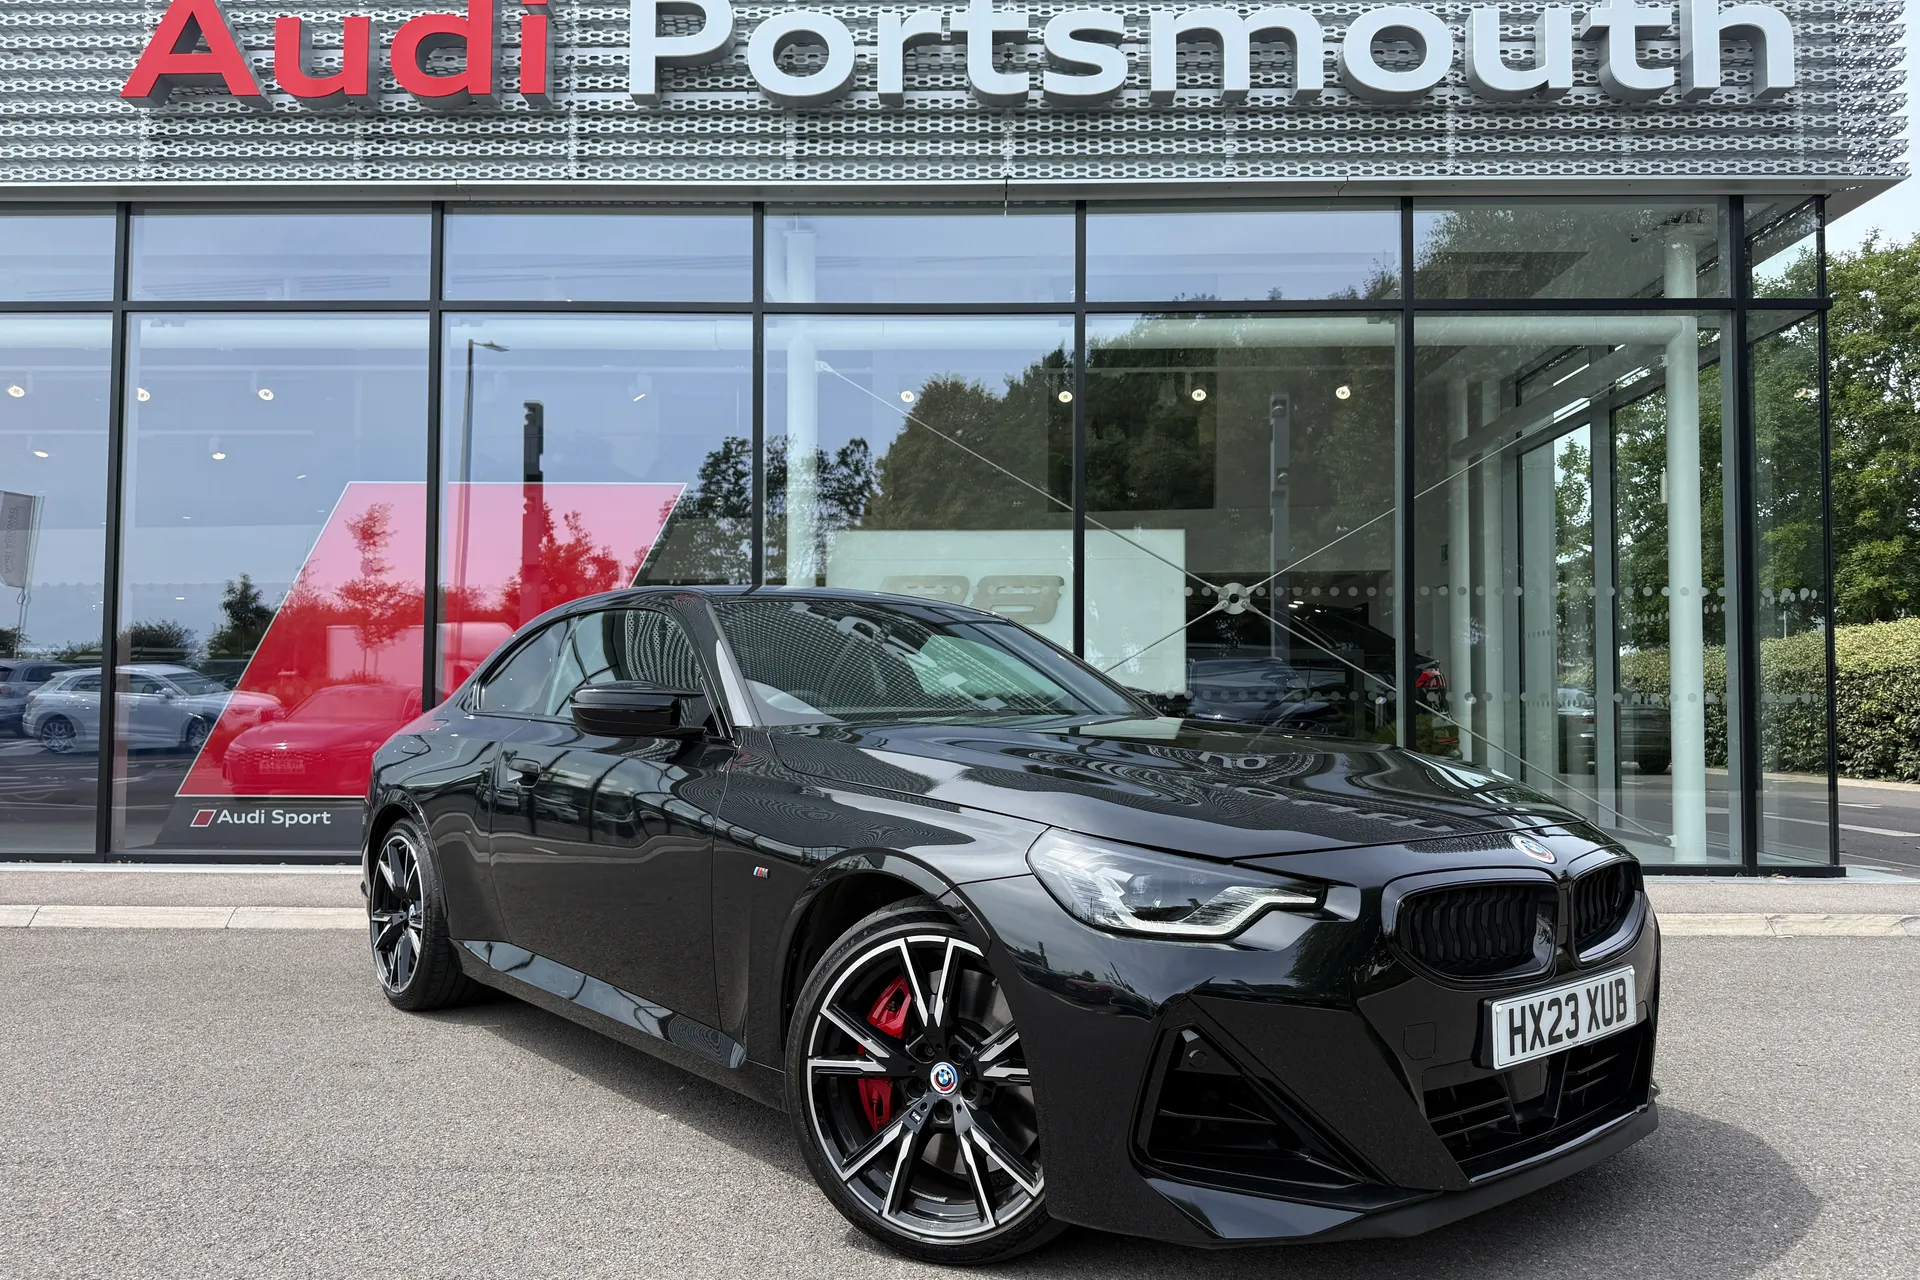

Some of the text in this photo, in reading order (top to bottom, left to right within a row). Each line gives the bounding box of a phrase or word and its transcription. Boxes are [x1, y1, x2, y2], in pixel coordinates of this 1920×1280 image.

[120, 0, 1796, 98] Audi Portsmouth
[216, 809, 331, 828] Audi Sport
[1508, 977, 1627, 1057] HX23 XUB
